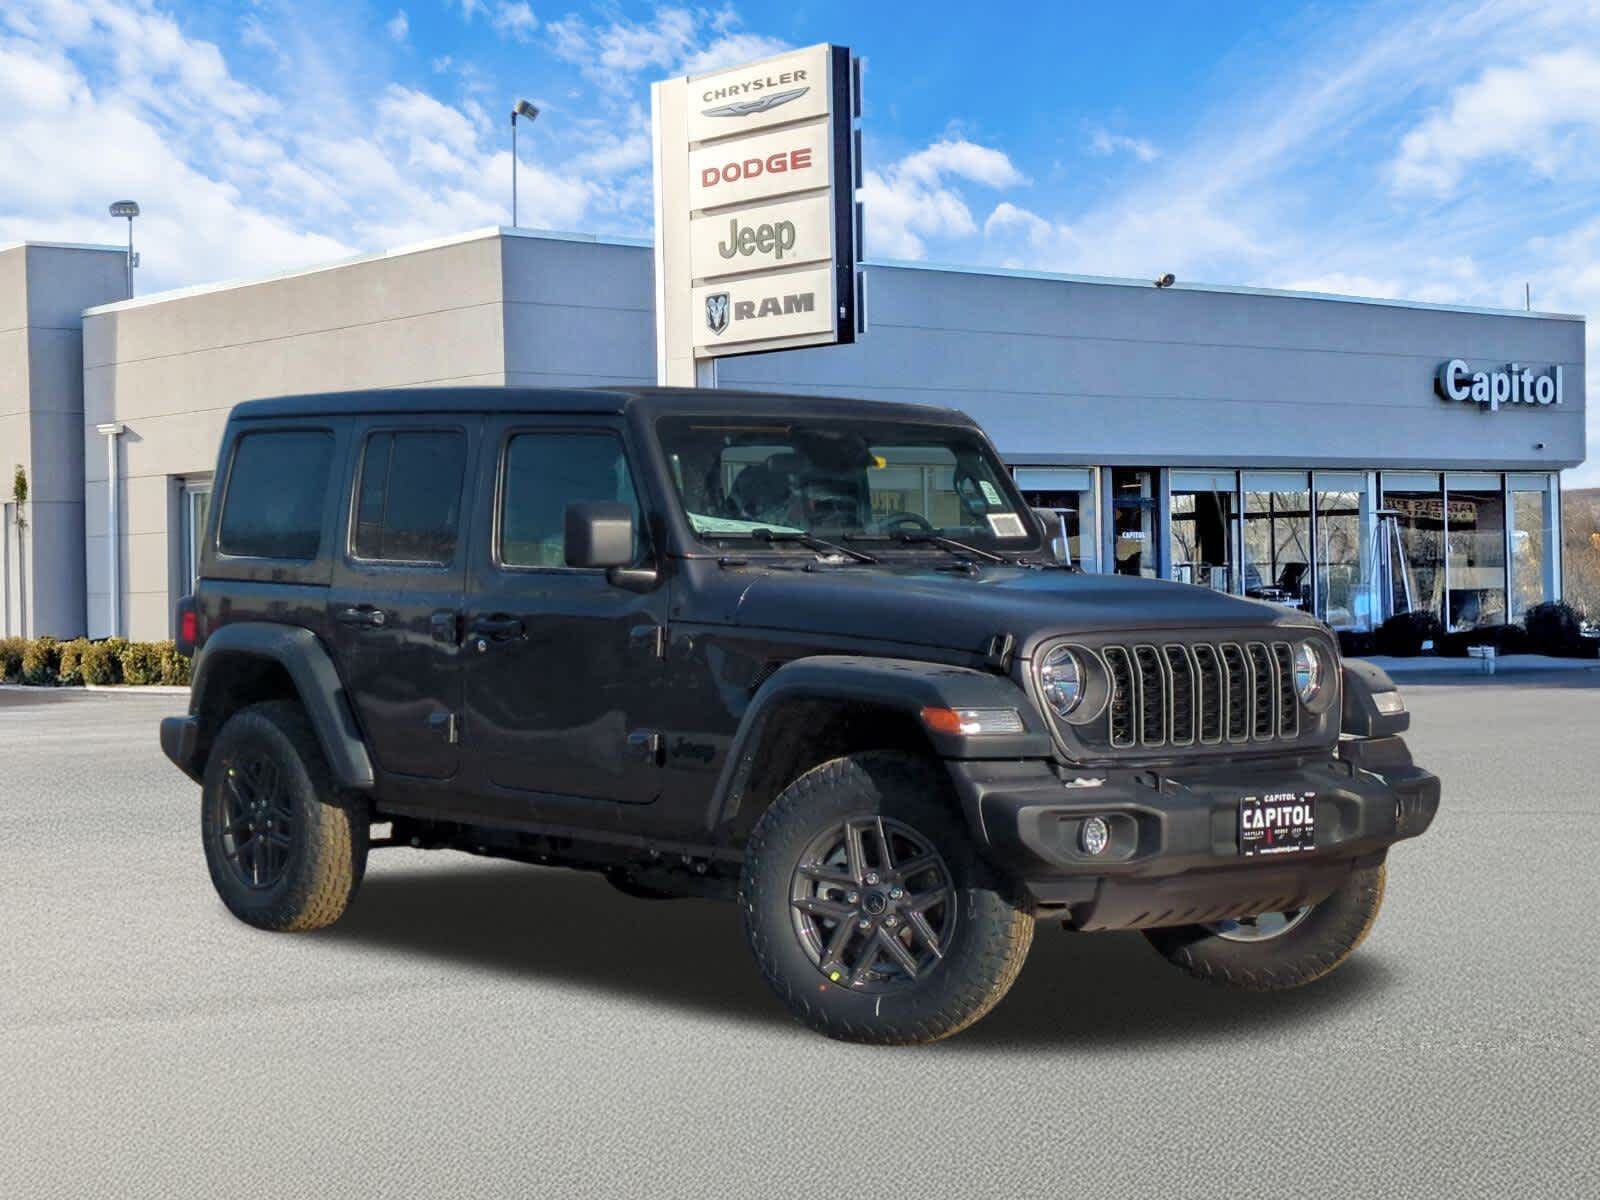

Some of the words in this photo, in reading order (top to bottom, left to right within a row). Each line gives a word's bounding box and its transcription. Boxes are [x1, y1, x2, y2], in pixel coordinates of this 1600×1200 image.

[703, 70, 808, 103] CHRYSLER
[702, 147, 812, 188] DODGE
[718, 218, 796, 260] Jeep
[734, 292, 815, 321] RAM
[1446, 359, 1563, 411] Capitol
[1264, 793, 1296, 803] CAPITOL
[1243, 805, 1314, 829] CAPITOL
